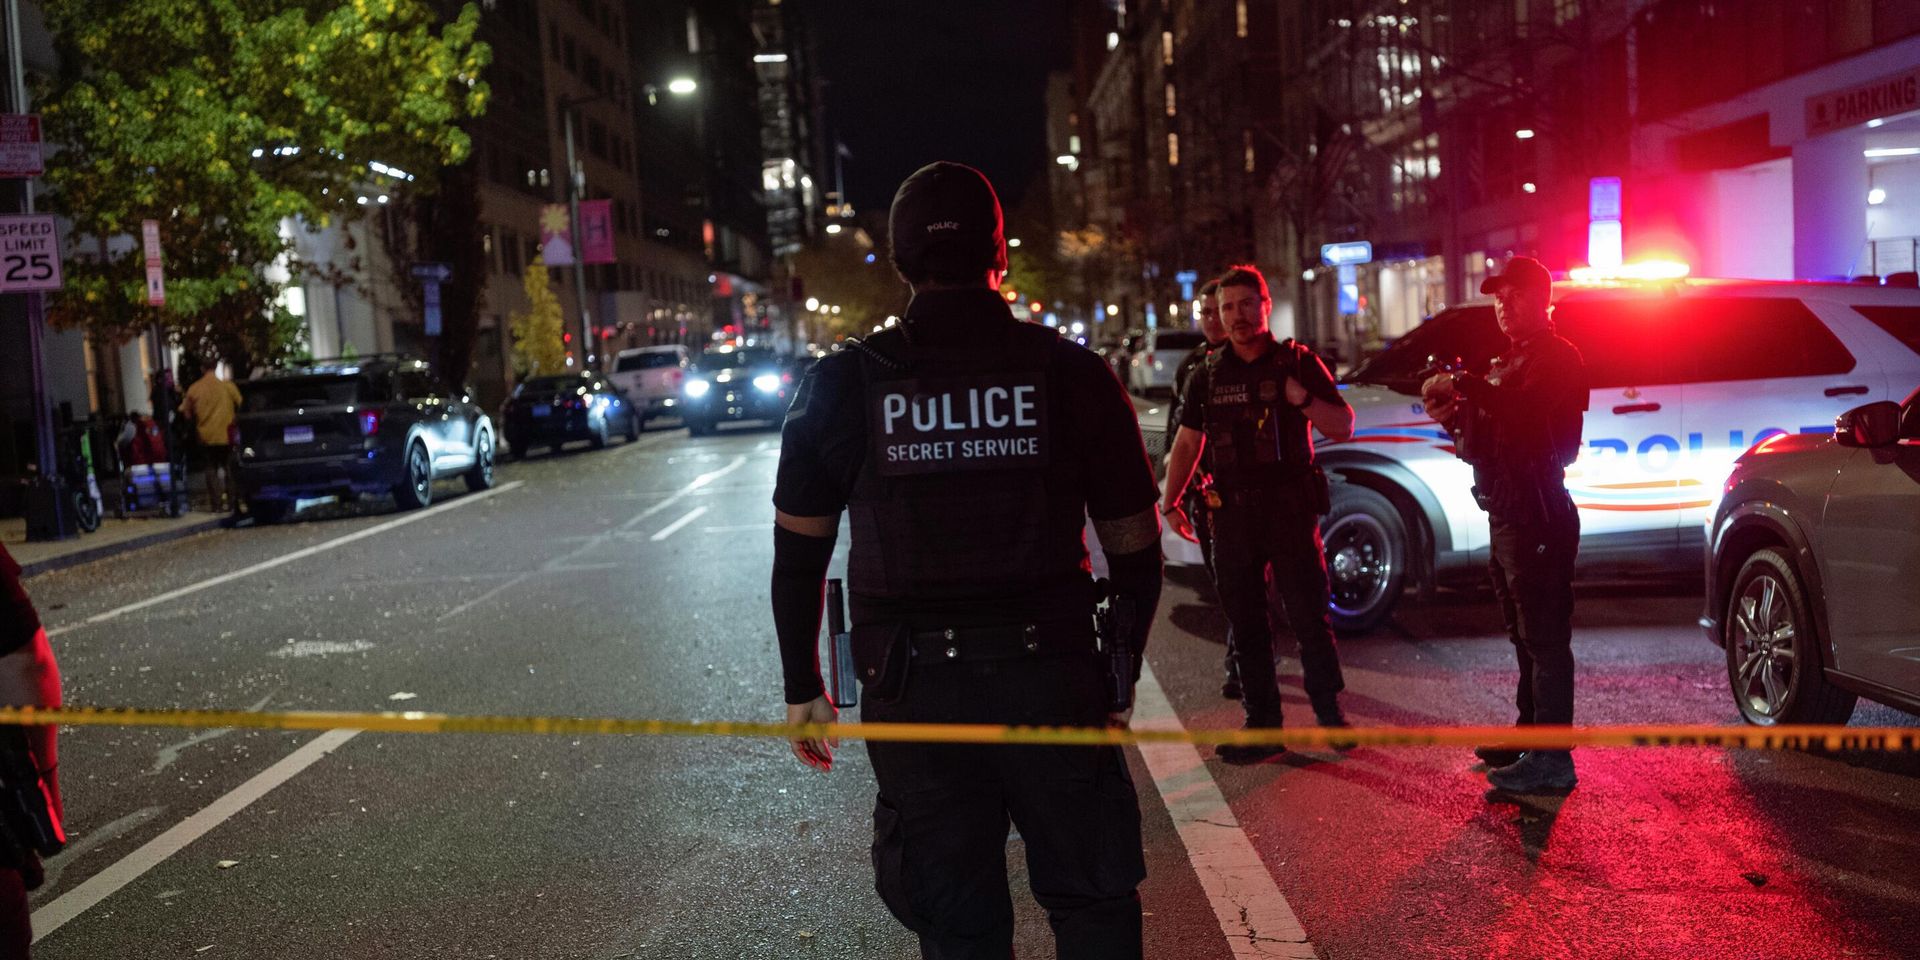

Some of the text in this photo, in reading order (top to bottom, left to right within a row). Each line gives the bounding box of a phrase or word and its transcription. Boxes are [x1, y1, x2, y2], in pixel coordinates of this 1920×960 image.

[1836, 76, 1917, 121] PARKING
[0, 222, 51, 236] SPEED
[926, 219, 961, 233] POLICE
[4, 238, 46, 251] LIMIT
[4, 254, 53, 281] 25
[1214, 383, 1247, 395] SECRET
[1212, 392, 1249, 405] SERVICE
[883, 385, 1038, 434] POLICE
[887, 437, 1039, 462] SECRET SERVICE
